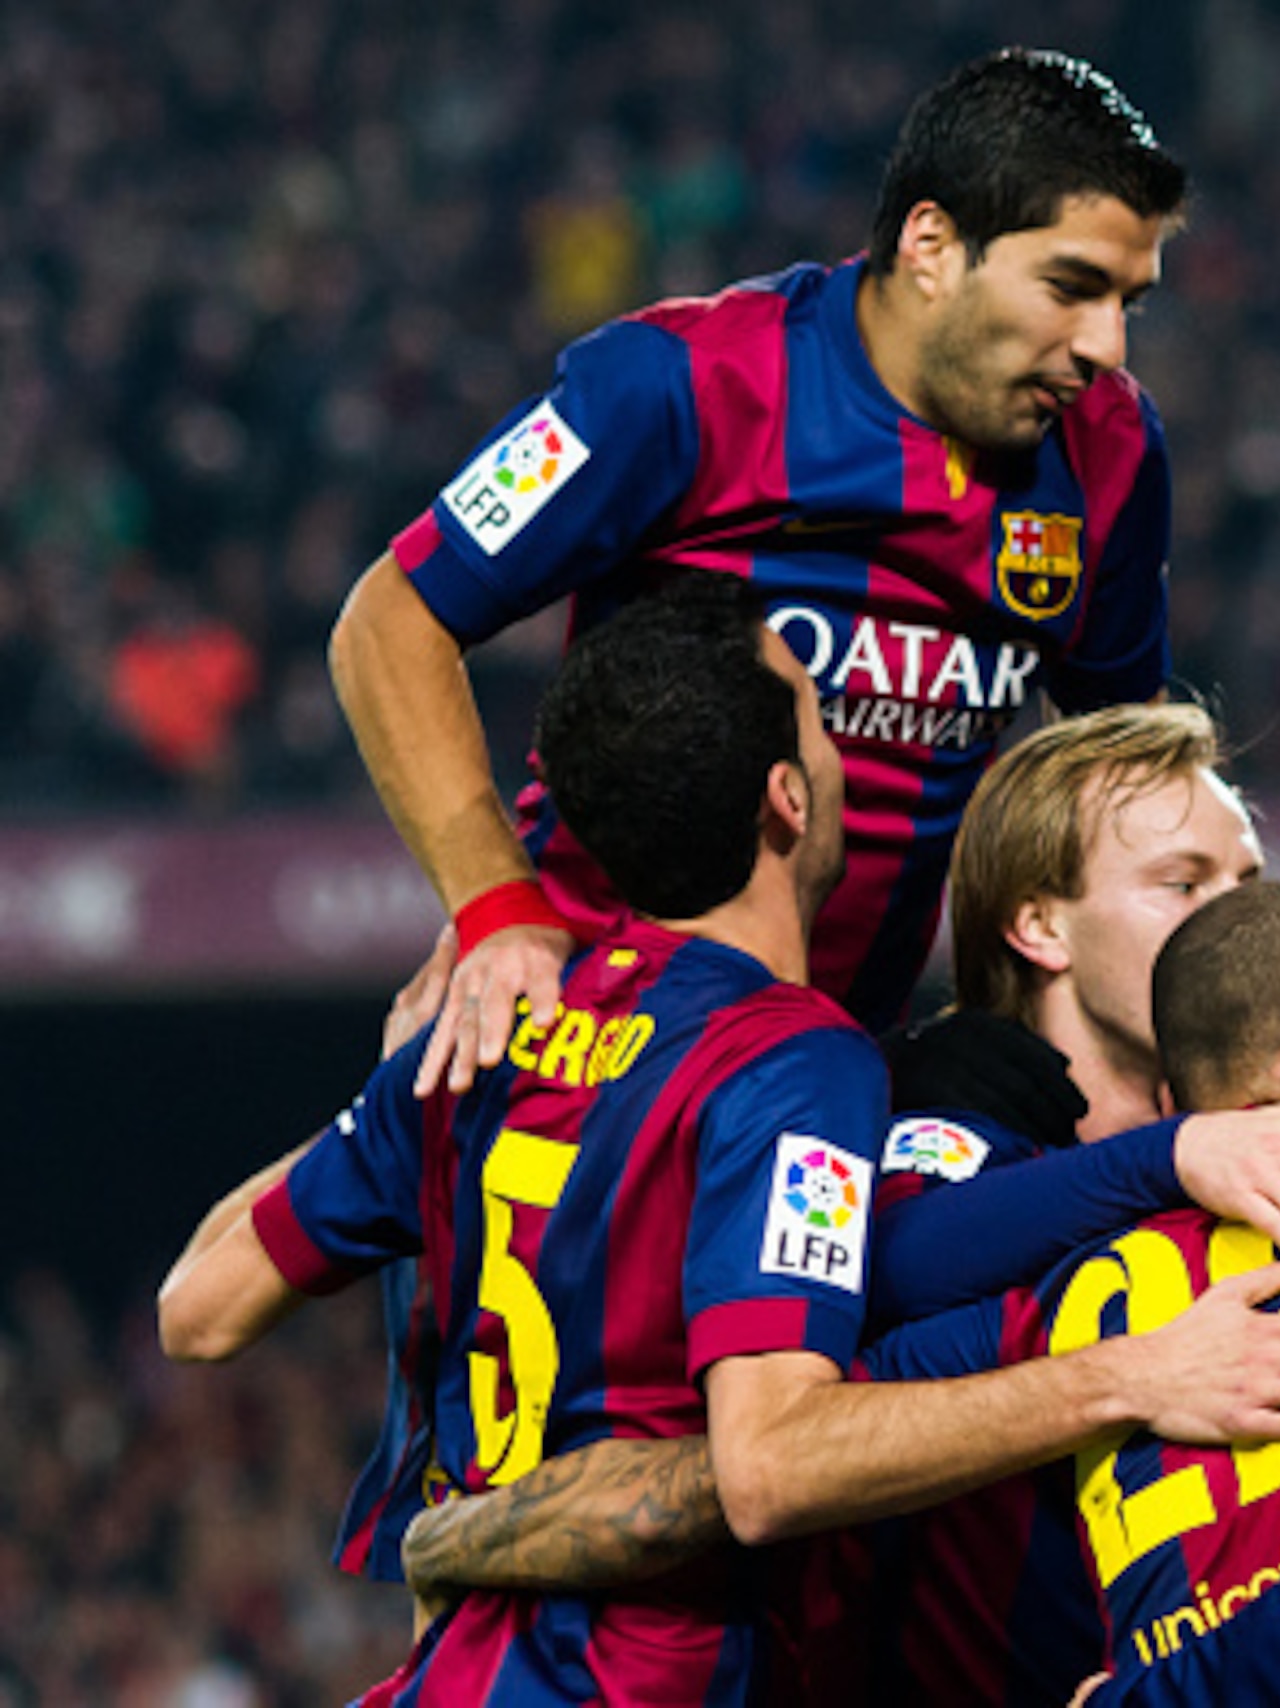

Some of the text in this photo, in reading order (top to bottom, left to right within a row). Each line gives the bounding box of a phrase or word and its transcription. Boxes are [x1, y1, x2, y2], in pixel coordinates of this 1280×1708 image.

[454, 471, 511, 531] LFP
[765, 606, 1040, 708] QATAR
[776, 1230, 849, 1277] LFP
[468, 1129, 580, 1486] 5
